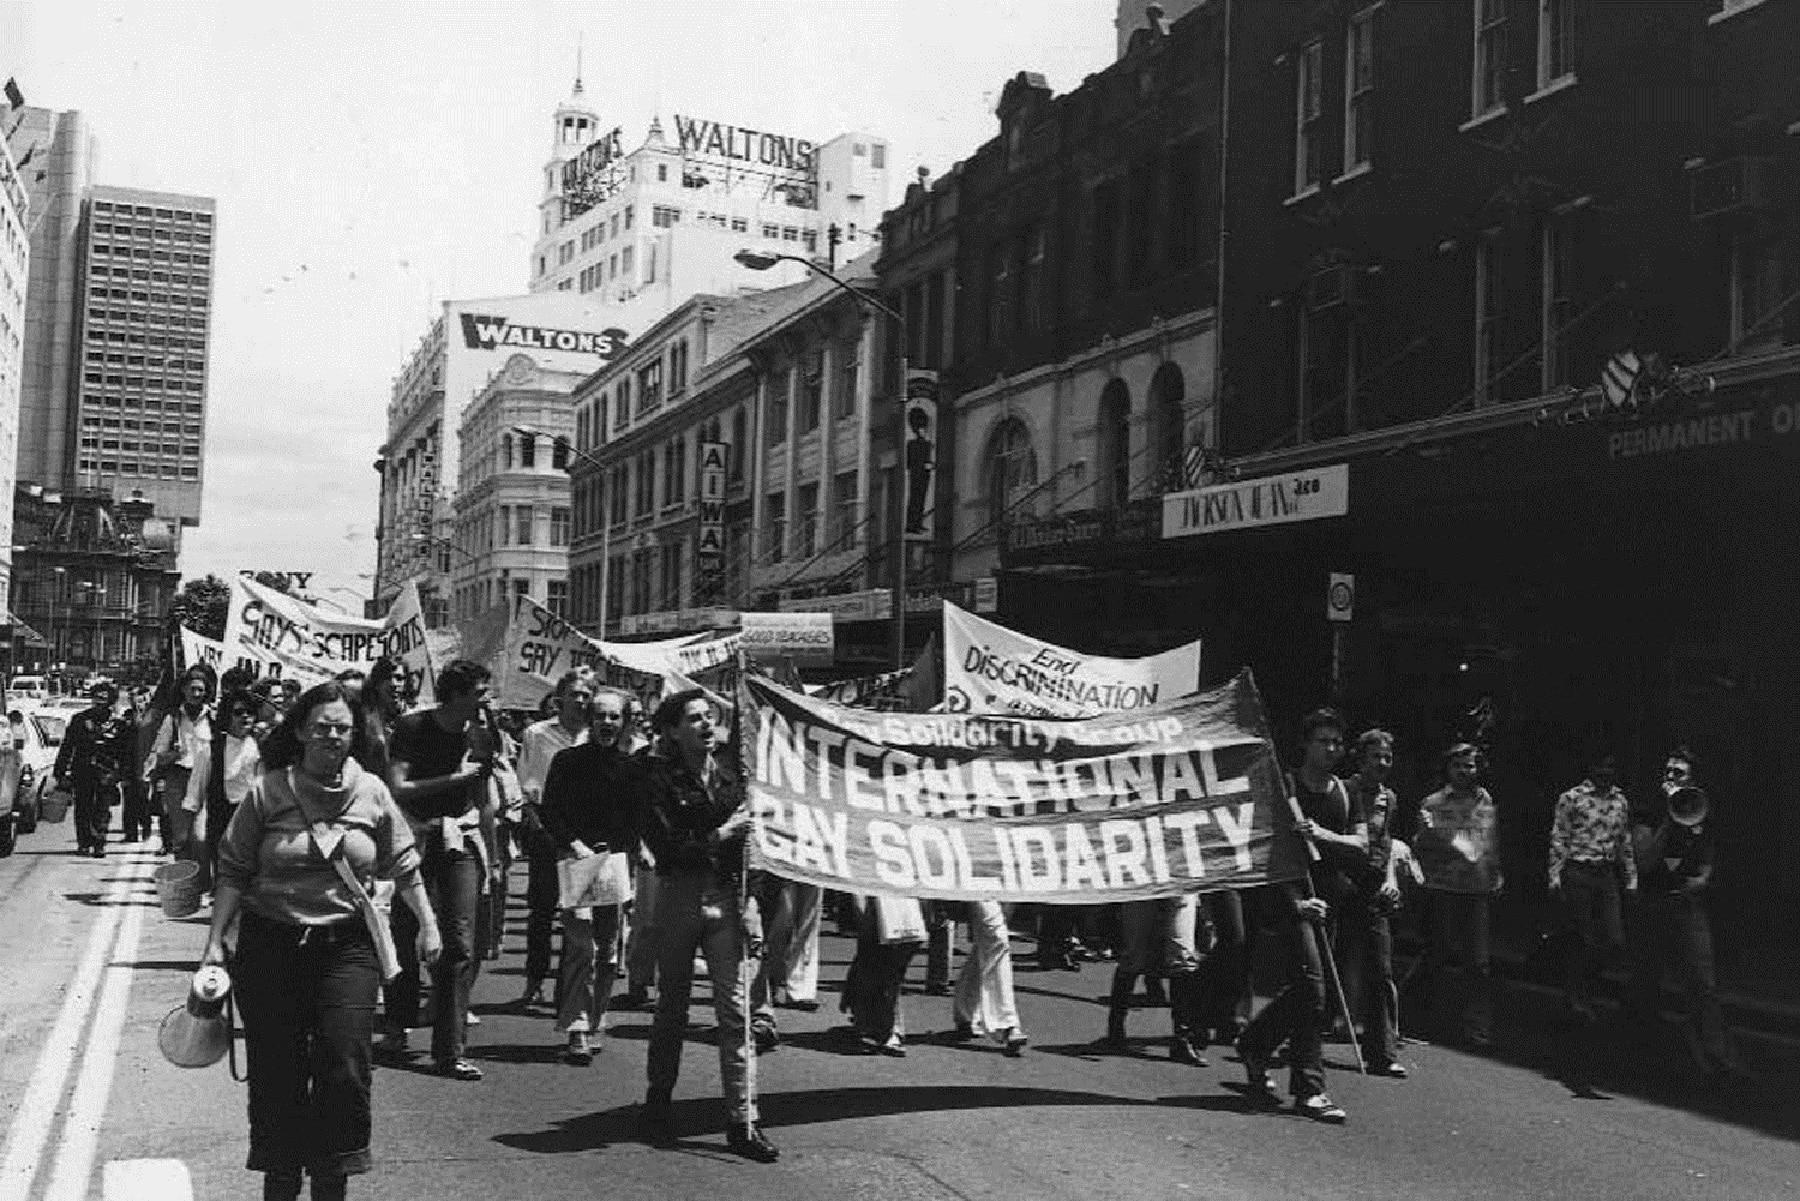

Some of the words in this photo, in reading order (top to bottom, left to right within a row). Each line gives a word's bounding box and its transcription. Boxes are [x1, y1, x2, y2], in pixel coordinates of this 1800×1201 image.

[673, 114, 812, 171] WALTONS
[465, 319, 614, 356] WALTONS
[1608, 410, 1756, 460] PERMANENT
[1771, 403, 1800, 434] O
[701, 447, 723, 549] AIWA
[517, 641, 563, 677] SAY
[1032, 648, 1082, 675] End
[756, 706, 1250, 818] INTERNATIONAL
[753, 796, 851, 878] GAY
[869, 802, 1256, 891] SOLIDARITY
